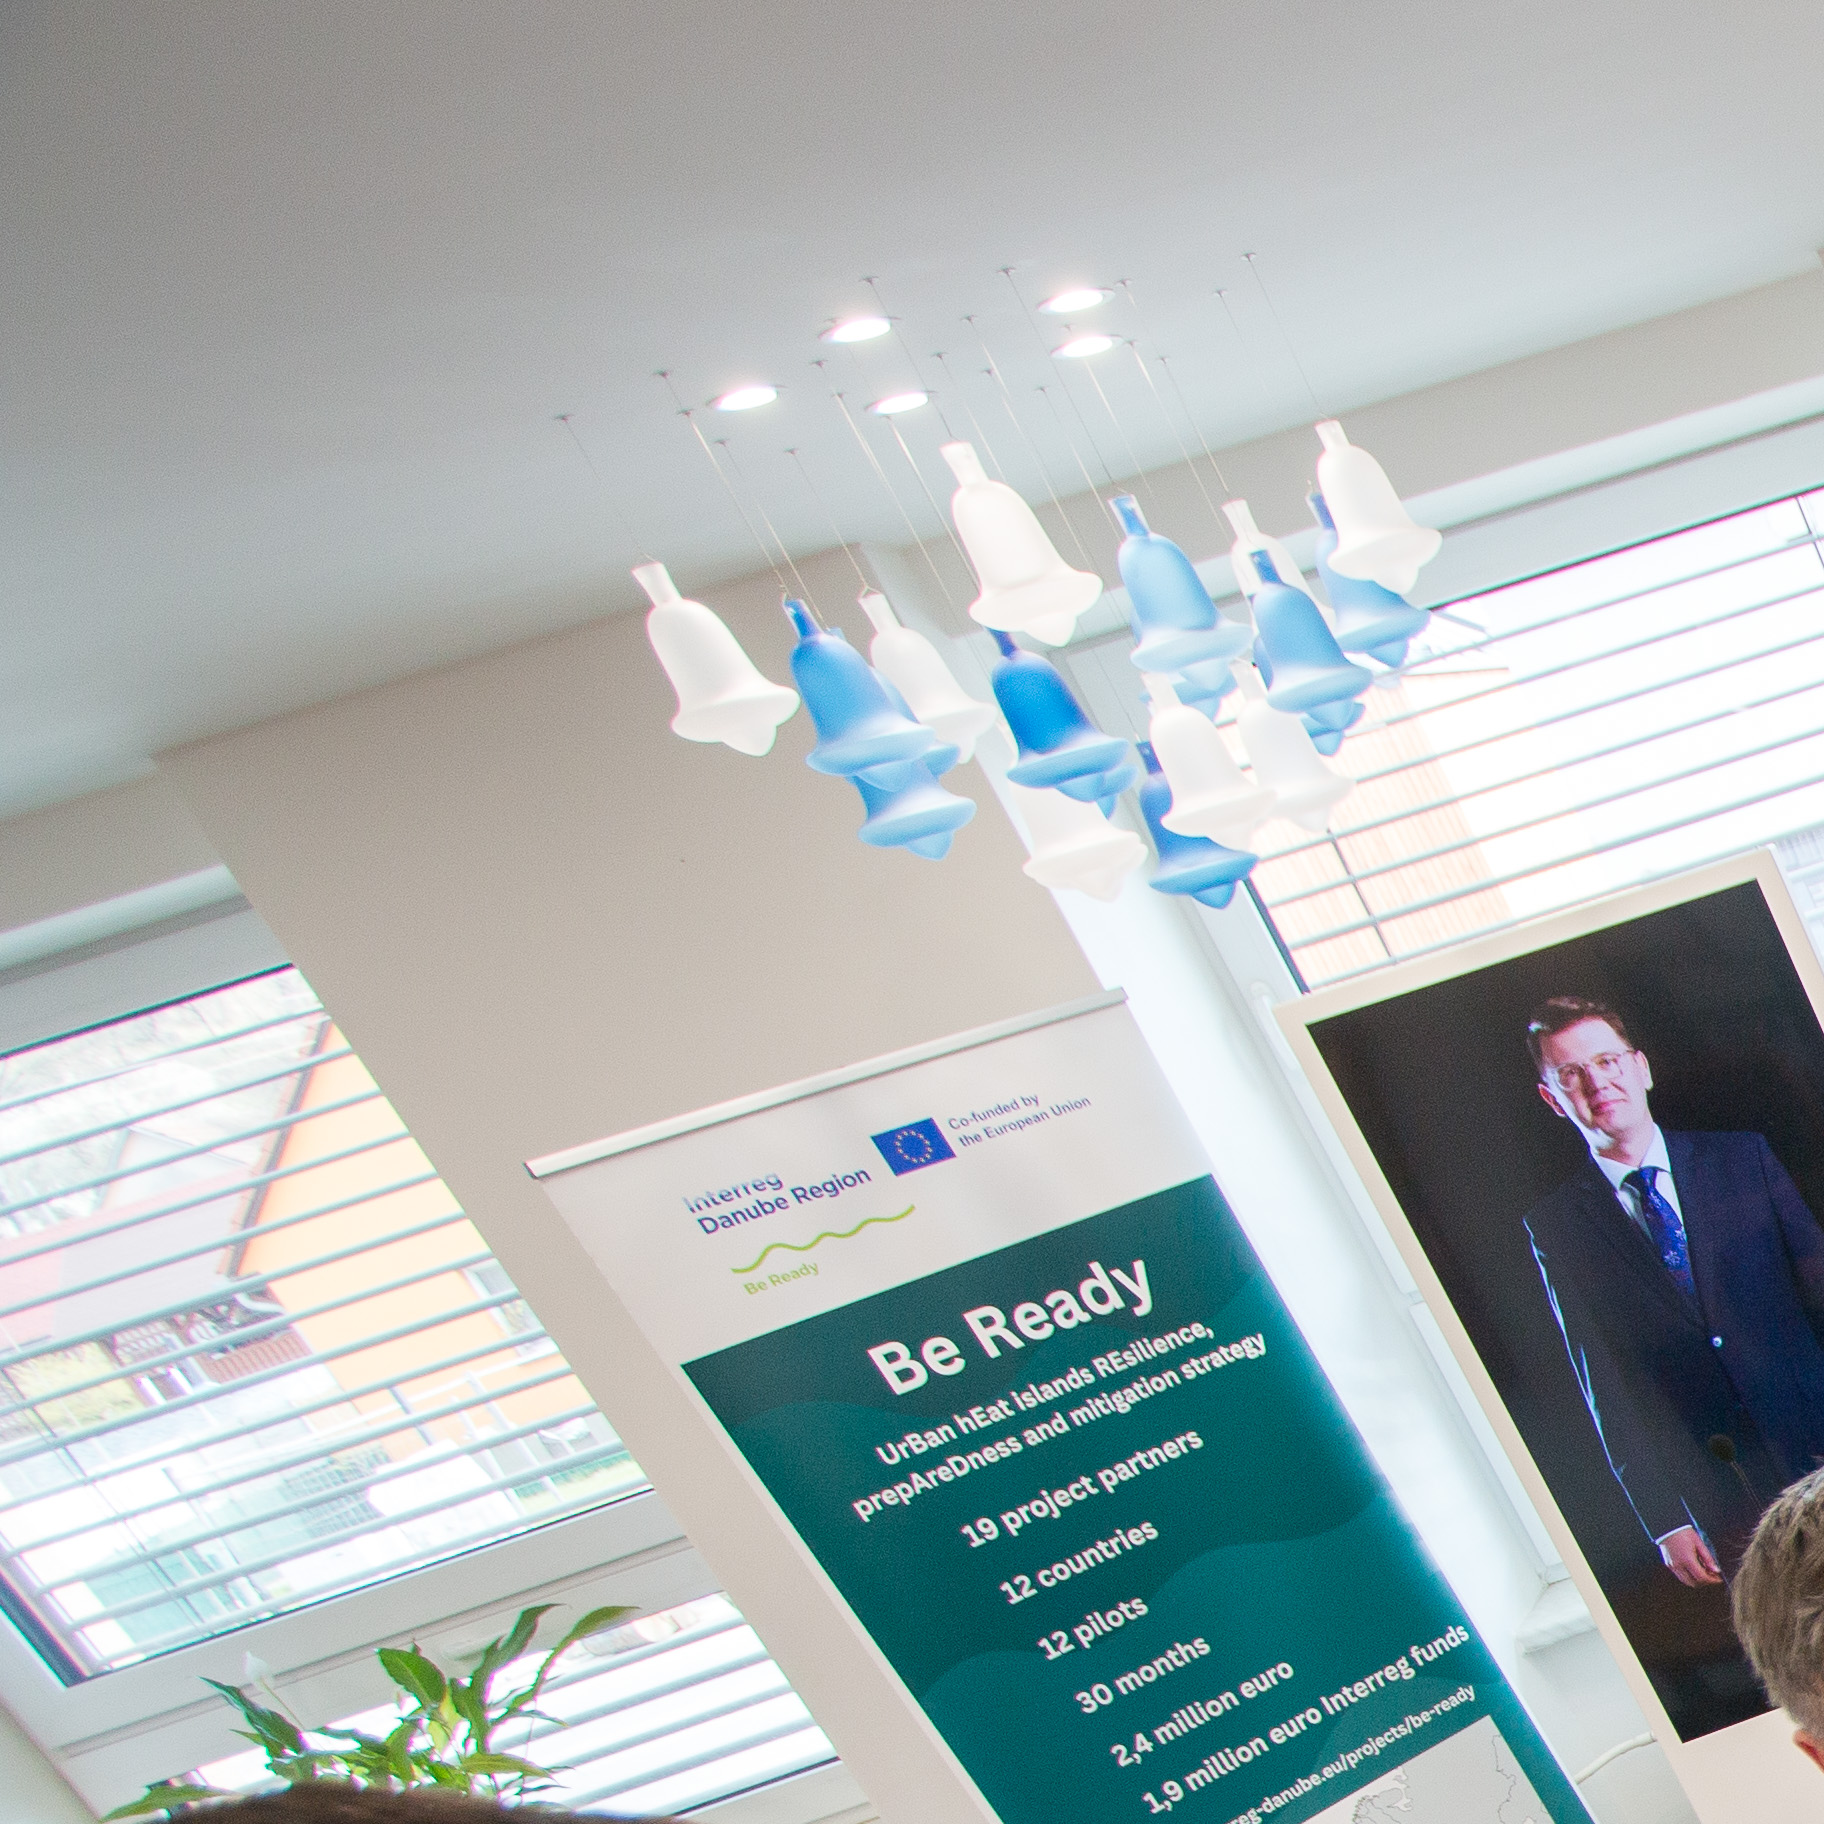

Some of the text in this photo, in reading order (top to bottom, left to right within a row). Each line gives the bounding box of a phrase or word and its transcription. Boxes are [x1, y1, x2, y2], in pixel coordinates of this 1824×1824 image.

[947, 1092, 1040, 1131] Co-funded by
[957, 1094, 1093, 1149] the European Union
[681, 1172, 784, 1214] Interreg
[697, 1167, 873, 1236] Danube Region
[742, 1260, 820, 1297] Be Ready
[867, 1258, 1153, 1396] Be Ready
[851, 1333, 1267, 1523] prepAreDness and mitigation strategy
[875, 1322, 1215, 1466] UrBan hEat islands REsilience,
[960, 1431, 1204, 1548] 19 project partners
[999, 1521, 1158, 1605] 12 countries
[1037, 1598, 1149, 1660] 12 pilots
[1075, 1637, 1211, 1714] 30 months
[1110, 1662, 1294, 1768] 2,4 million euro
[1142, 1625, 1470, 1815] 1,9 million euro Interreg funds
